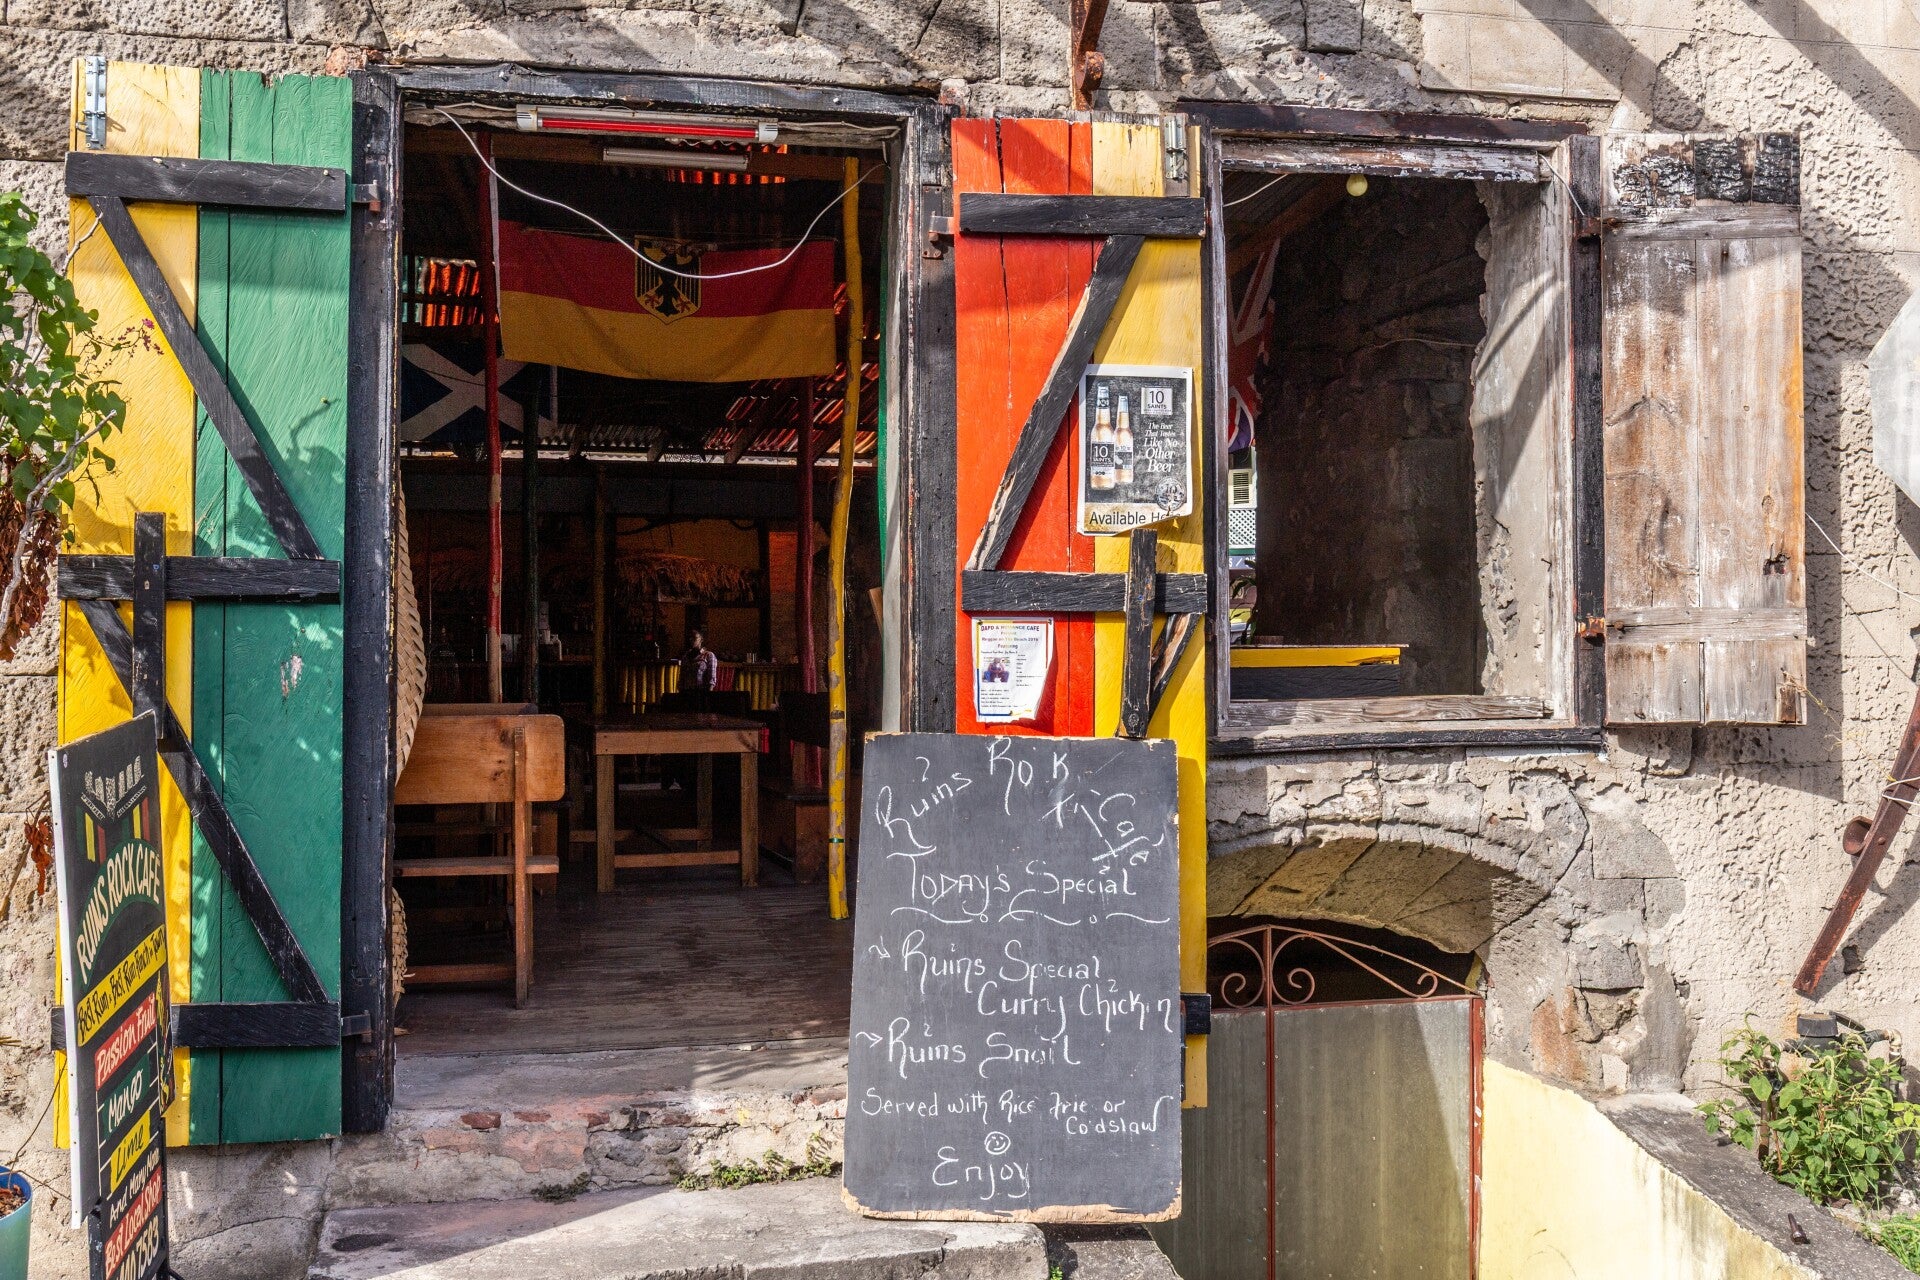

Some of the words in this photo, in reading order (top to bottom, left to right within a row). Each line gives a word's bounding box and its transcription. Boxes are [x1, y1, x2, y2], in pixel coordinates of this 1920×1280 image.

[1149, 391, 1165, 404] 10
[1094, 446, 1109, 458] 10
[1144, 437, 1163, 447] Like
[1164, 438, 1179, 448] No
[1145, 447, 1176, 459] Other
[1147, 459, 1175, 472] Beer
[1089, 512, 1146, 525] Available
[77, 875, 109, 985] RUINS
[107, 843, 136, 914] ROCK
[78, 998, 96, 1043] Best
[110, 968, 125, 1008] Best
[123, 960, 138, 992] Rum
[96, 1025, 137, 1087] Passion
[136, 992, 157, 1040] Fruit
[108, 1067, 144, 1132] Mango
[861, 1087, 938, 1117] Served
[948, 1090, 988, 1124] with
[1103, 1099, 1126, 1113] or
[115, 1123, 144, 1184] Lime
[932, 1146, 1030, 1200] Enjoy
[105, 1222, 124, 1280] Best
[124, 1192, 145, 1250] Local
[144, 1173, 161, 1221] Shop
[109, 1185, 127, 1229] And
[136, 1214, 159, 1280] 7583
